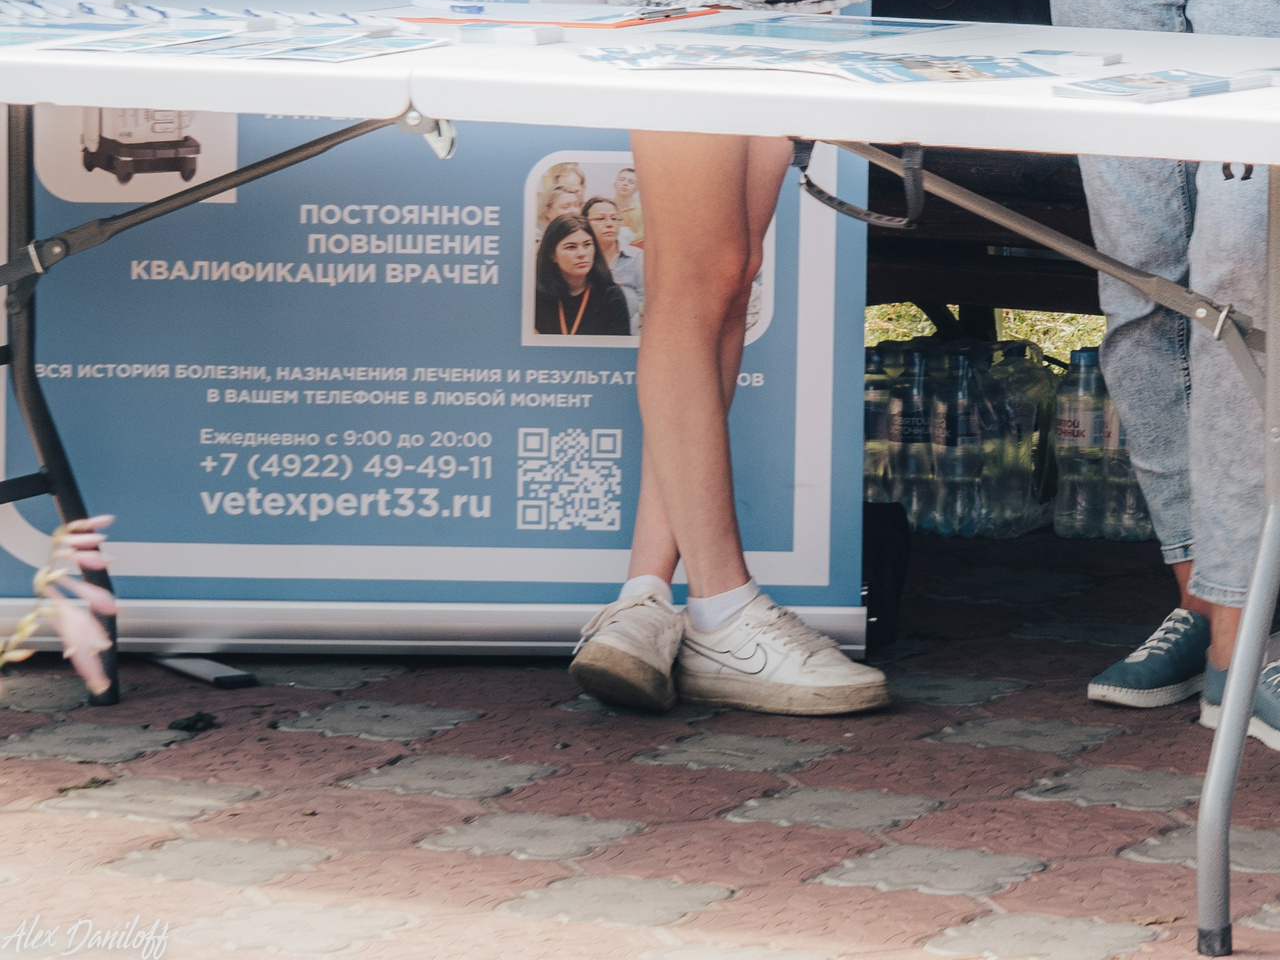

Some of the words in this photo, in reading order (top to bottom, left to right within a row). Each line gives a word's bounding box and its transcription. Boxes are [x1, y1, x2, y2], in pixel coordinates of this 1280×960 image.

[300, 203, 501, 227] ПОСТОЯННОЕ
[307, 233, 500, 256] ПОВЫШЕНИЕ
[130, 260, 377, 286] КВАЛИФИКАЦИИ
[384, 260, 499, 285] ВРАЧЕЙ
[77, 363, 171, 379] ИСТОРИЯ
[174, 364, 272, 382] БОЛЕЗНИ,
[275, 366, 408, 382] НАЗНАЧЕНИЯ
[411, 368, 502, 382] ЛЕЧЕНИЯ
[506, 369, 521, 383] И
[206, 388, 221, 403] В
[225, 389, 299, 404] ВАШЕМ
[303, 390, 411, 405] ТЕЛЕФОНЕ
[414, 391, 428, 405] В
[431, 389, 505, 407] ЛЮБОЙ
[510, 393, 593, 408] МОМЕНТ
[199, 428, 320, 448] Ежедневно
[325, 432, 339, 446] с
[343, 429, 393, 447] 9:00
[396, 433, 425, 449] до
[430, 431, 493, 448] 20:00
[200, 452, 239, 477] +7
[246, 453, 354, 481] (4922)
[362, 454, 493, 480] 49-49-11
[199, 487, 492, 523] vetexpert33.ru
